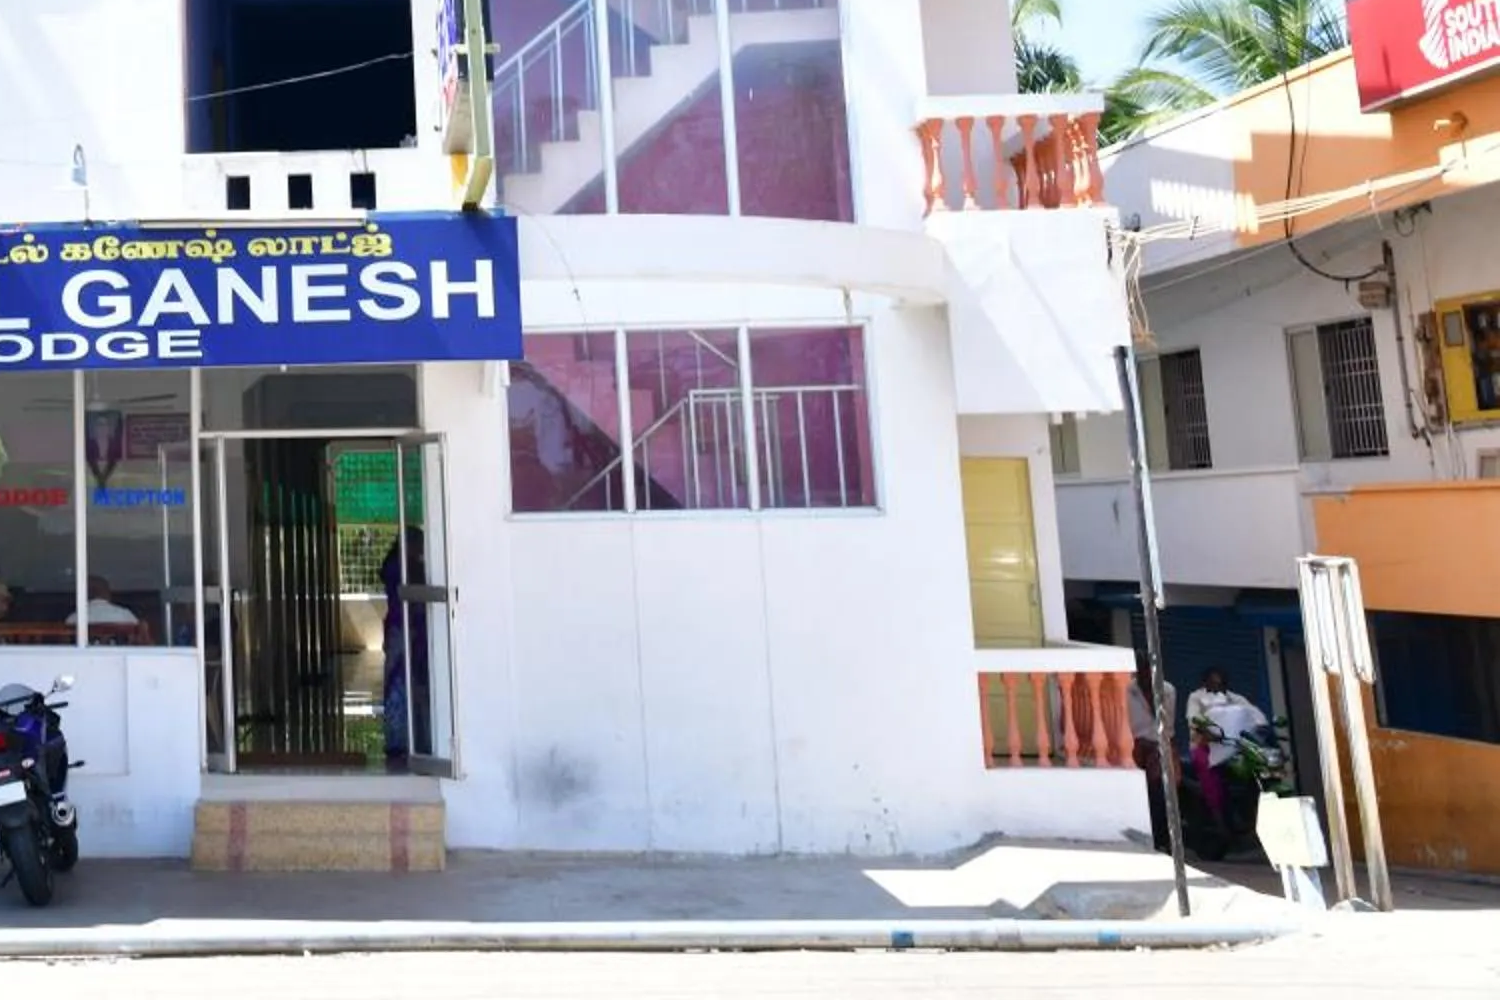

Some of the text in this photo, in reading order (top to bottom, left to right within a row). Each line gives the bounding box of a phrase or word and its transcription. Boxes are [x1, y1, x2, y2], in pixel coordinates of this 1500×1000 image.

[60, 228, 237, 264] கணேஷ்
[247, 223, 393, 258] லாட்ஜ்
[62, 259, 496, 330] GANESH
